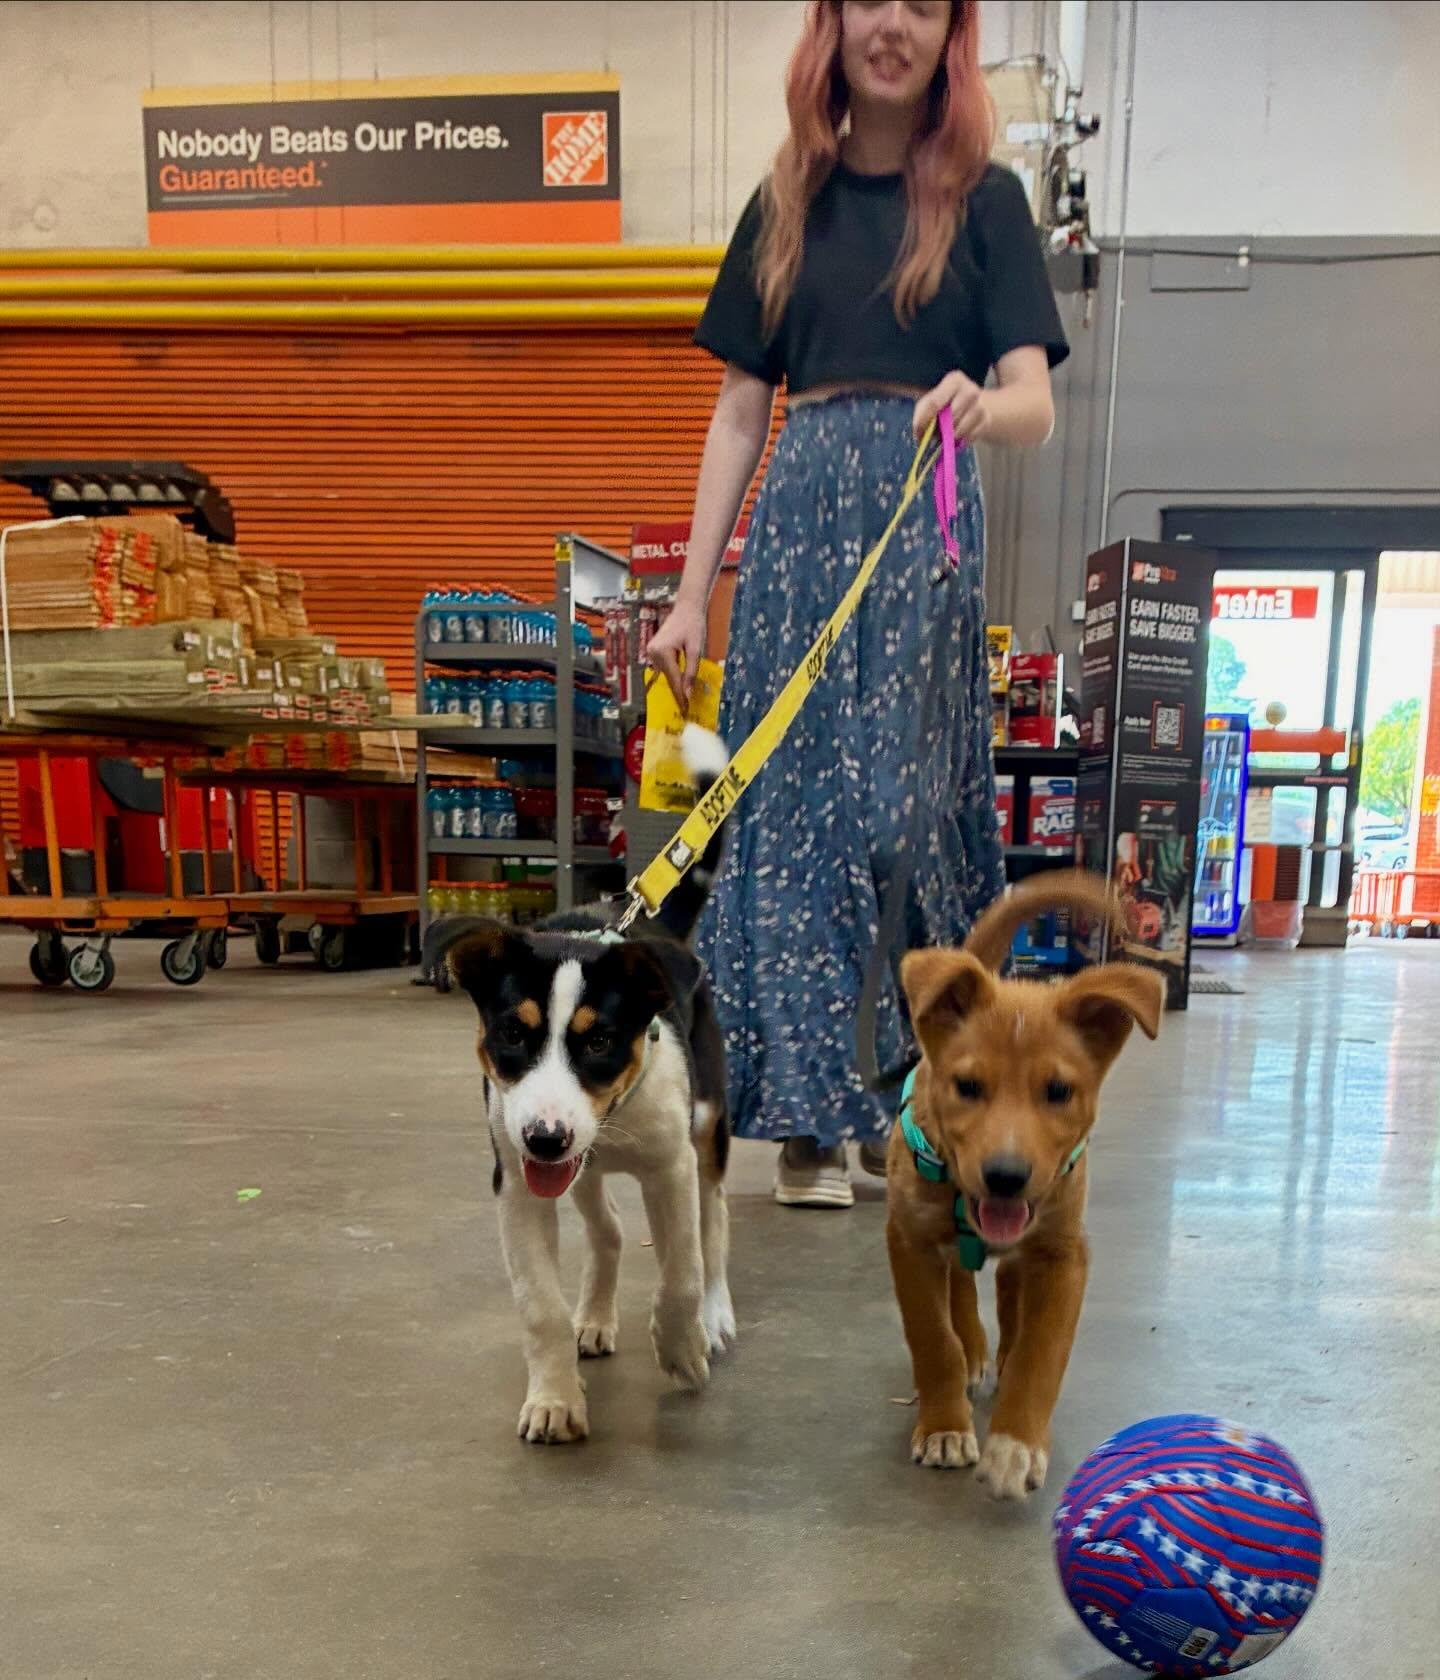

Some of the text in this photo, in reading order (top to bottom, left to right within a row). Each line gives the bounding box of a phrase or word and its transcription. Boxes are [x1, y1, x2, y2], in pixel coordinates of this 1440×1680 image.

[158, 121, 509, 163] Nobody Beats Our Prices.
[544, 112, 604, 184] HOME
[1130, 598, 1160, 618] EARN
[1129, 619, 1157, 639] SAVE
[1033, 813, 1075, 837] RAG
